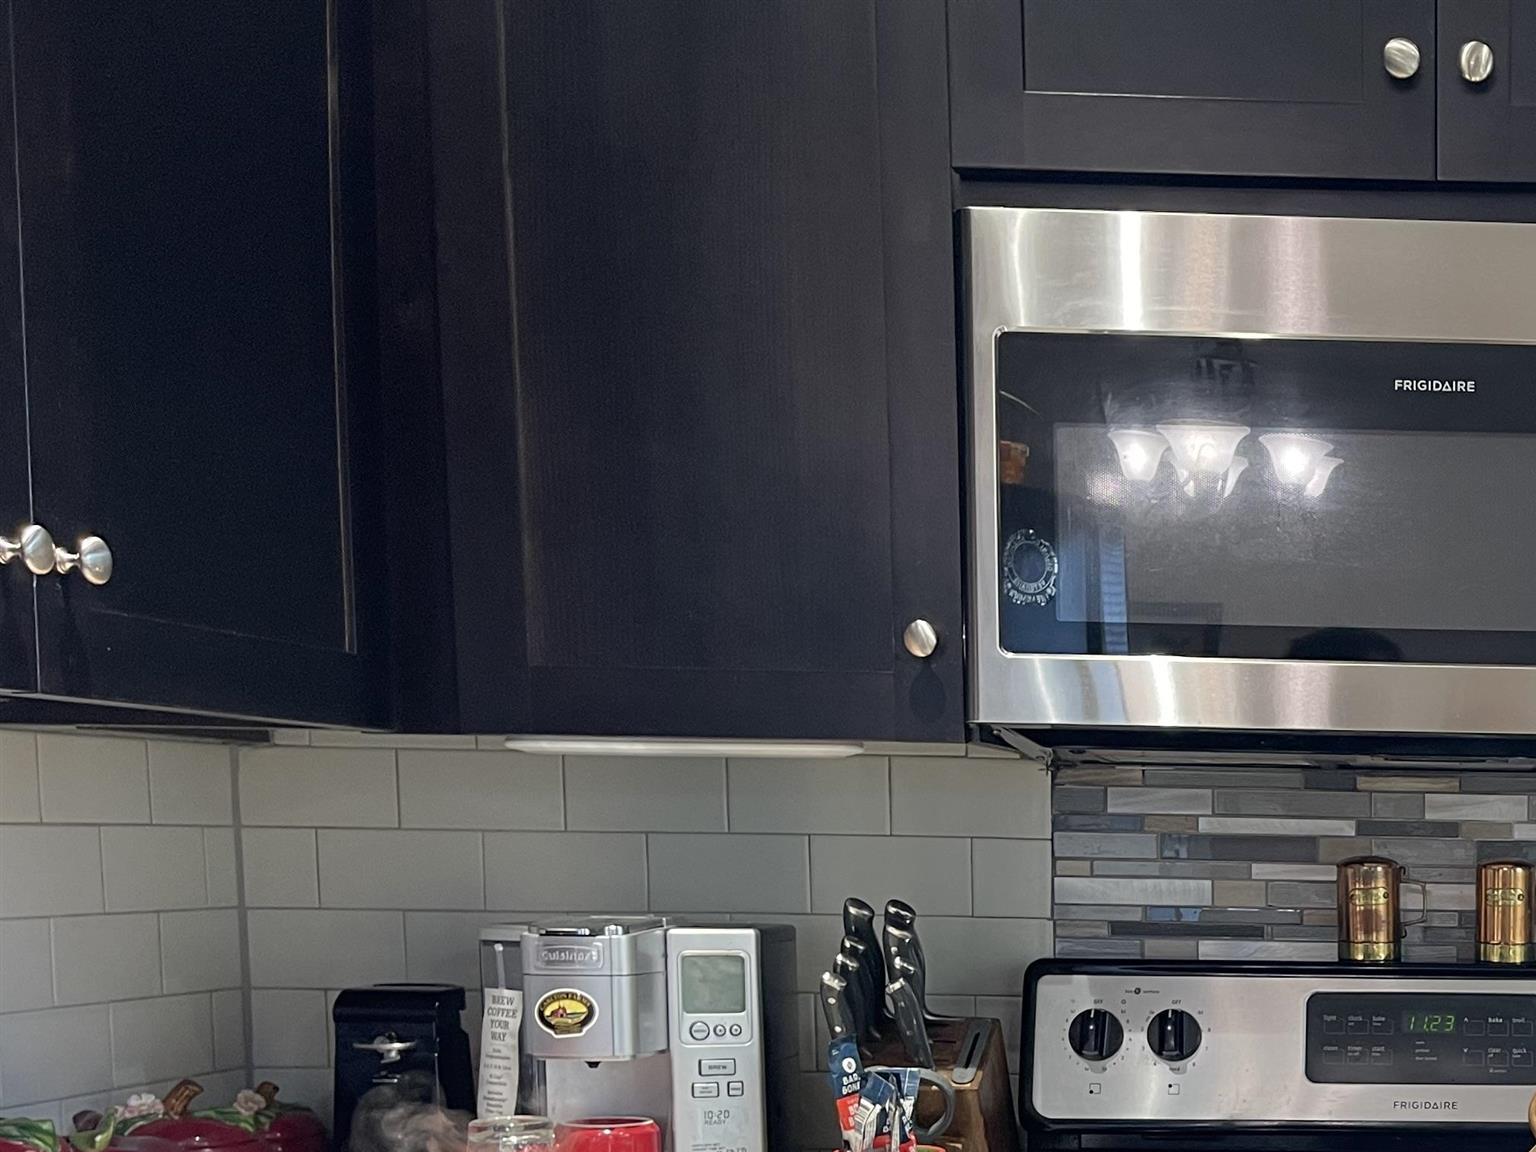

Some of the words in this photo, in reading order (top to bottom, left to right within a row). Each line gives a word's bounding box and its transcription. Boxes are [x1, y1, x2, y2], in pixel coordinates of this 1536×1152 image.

[1394, 379, 1476, 392] FRIGIDAIRE
[491, 994, 516, 1006] BREW
[487, 1006, 518, 1019] COFFEE
[490, 1019, 510, 1030] YOUR
[490, 1031, 507, 1041] WAY
[1393, 1101, 1459, 1110] FRIGIDAIRE
